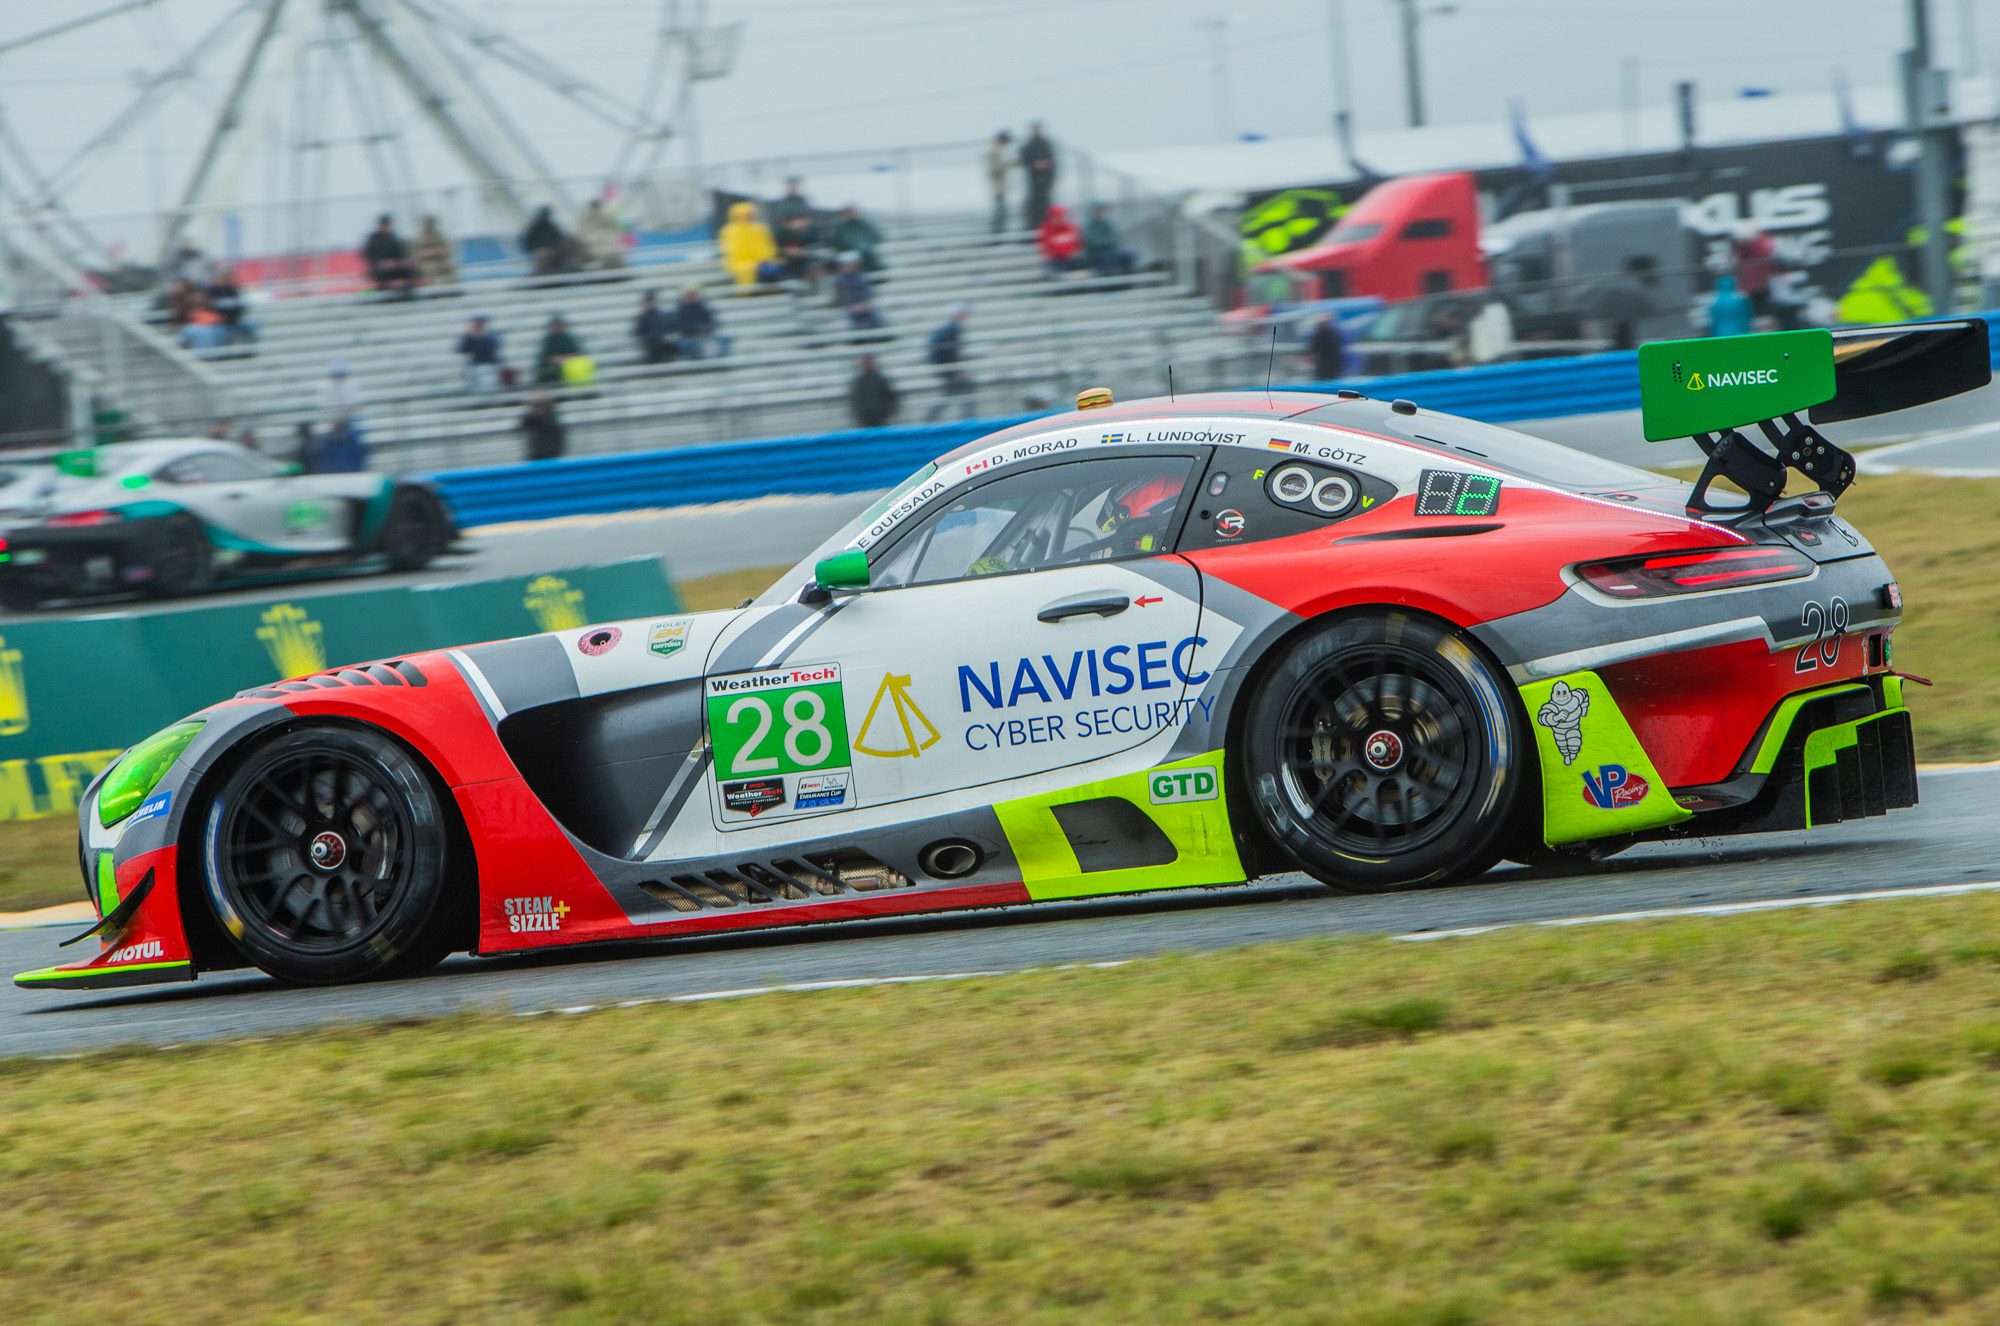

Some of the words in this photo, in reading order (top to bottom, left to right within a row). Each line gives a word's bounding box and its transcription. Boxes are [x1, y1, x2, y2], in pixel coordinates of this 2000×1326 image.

[1707, 369, 1778, 388] NAVISEC
[1126, 433, 1141, 443] L.
[1147, 431, 1246, 444] LUNDQVIST
[992, 455, 1008, 466] D.
[1013, 438, 1078, 459] MORAD
[1293, 442, 1312, 455] M.
[1317, 447, 1368, 466] GÖTZ
[1253, 469, 1265, 481] F
[870, 482, 946, 538] QUESADA
[656, 621, 686, 629] ROLEX
[1795, 595, 1850, 674] 28
[711, 667, 836, 692] WeatherTech
[957, 636, 1211, 713] NAVISEC
[726, 690, 833, 774] 28
[964, 715, 1067, 750] CYBER
[1075, 695, 1216, 738] SECURITY
[1152, 771, 1214, 798] GTD
[1582, 763, 1628, 809] VP
[1614, 782, 1649, 803] Racing
[130, 799, 166, 821] CHELIN
[504, 895, 553, 915] STEAK
[509, 912, 560, 933] SIZZLE
[107, 940, 164, 964] MOTUL
